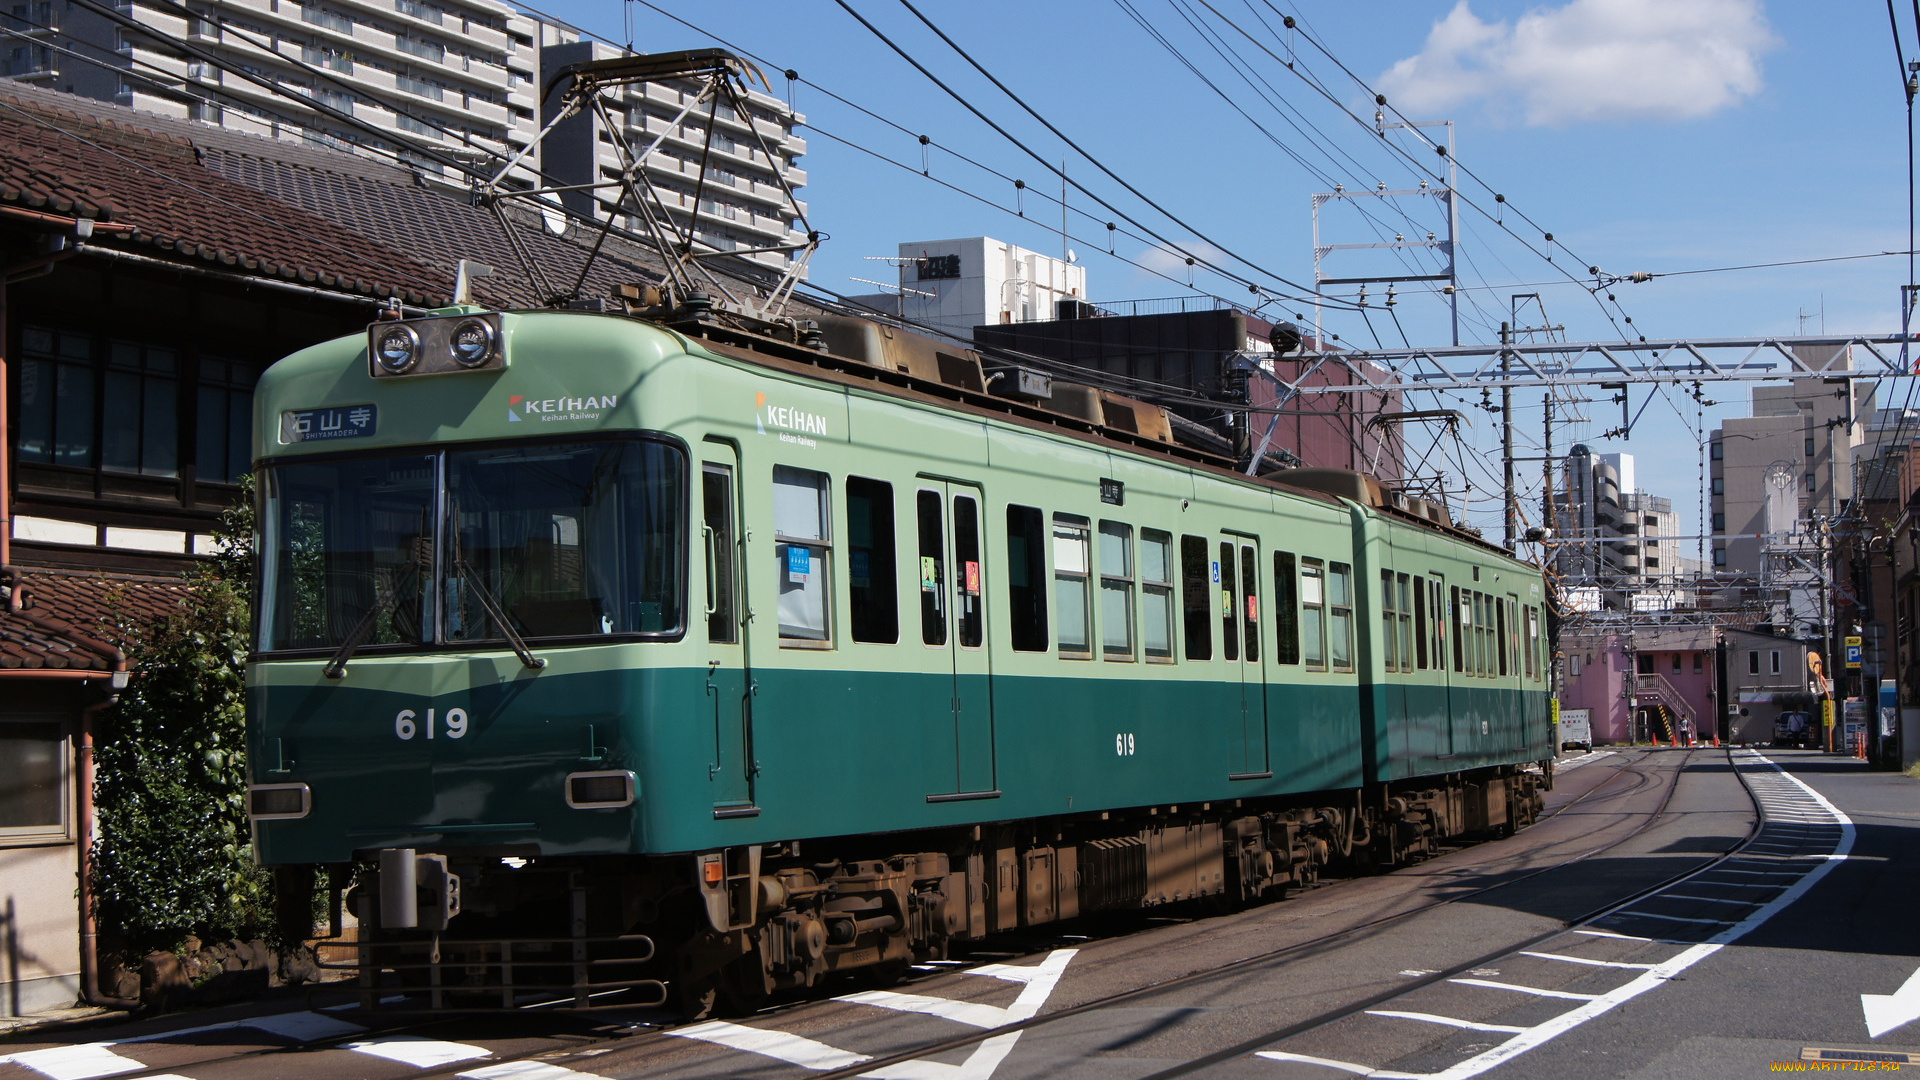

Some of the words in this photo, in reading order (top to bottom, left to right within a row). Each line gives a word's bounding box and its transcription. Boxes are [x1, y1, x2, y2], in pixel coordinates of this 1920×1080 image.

[293, 407, 371, 433] 石山寺
[541, 414, 568, 422] Keihan
[1848, 648, 1859, 661] P
[395, 707, 468, 740] 619
[1116, 733, 1135, 757] 619
